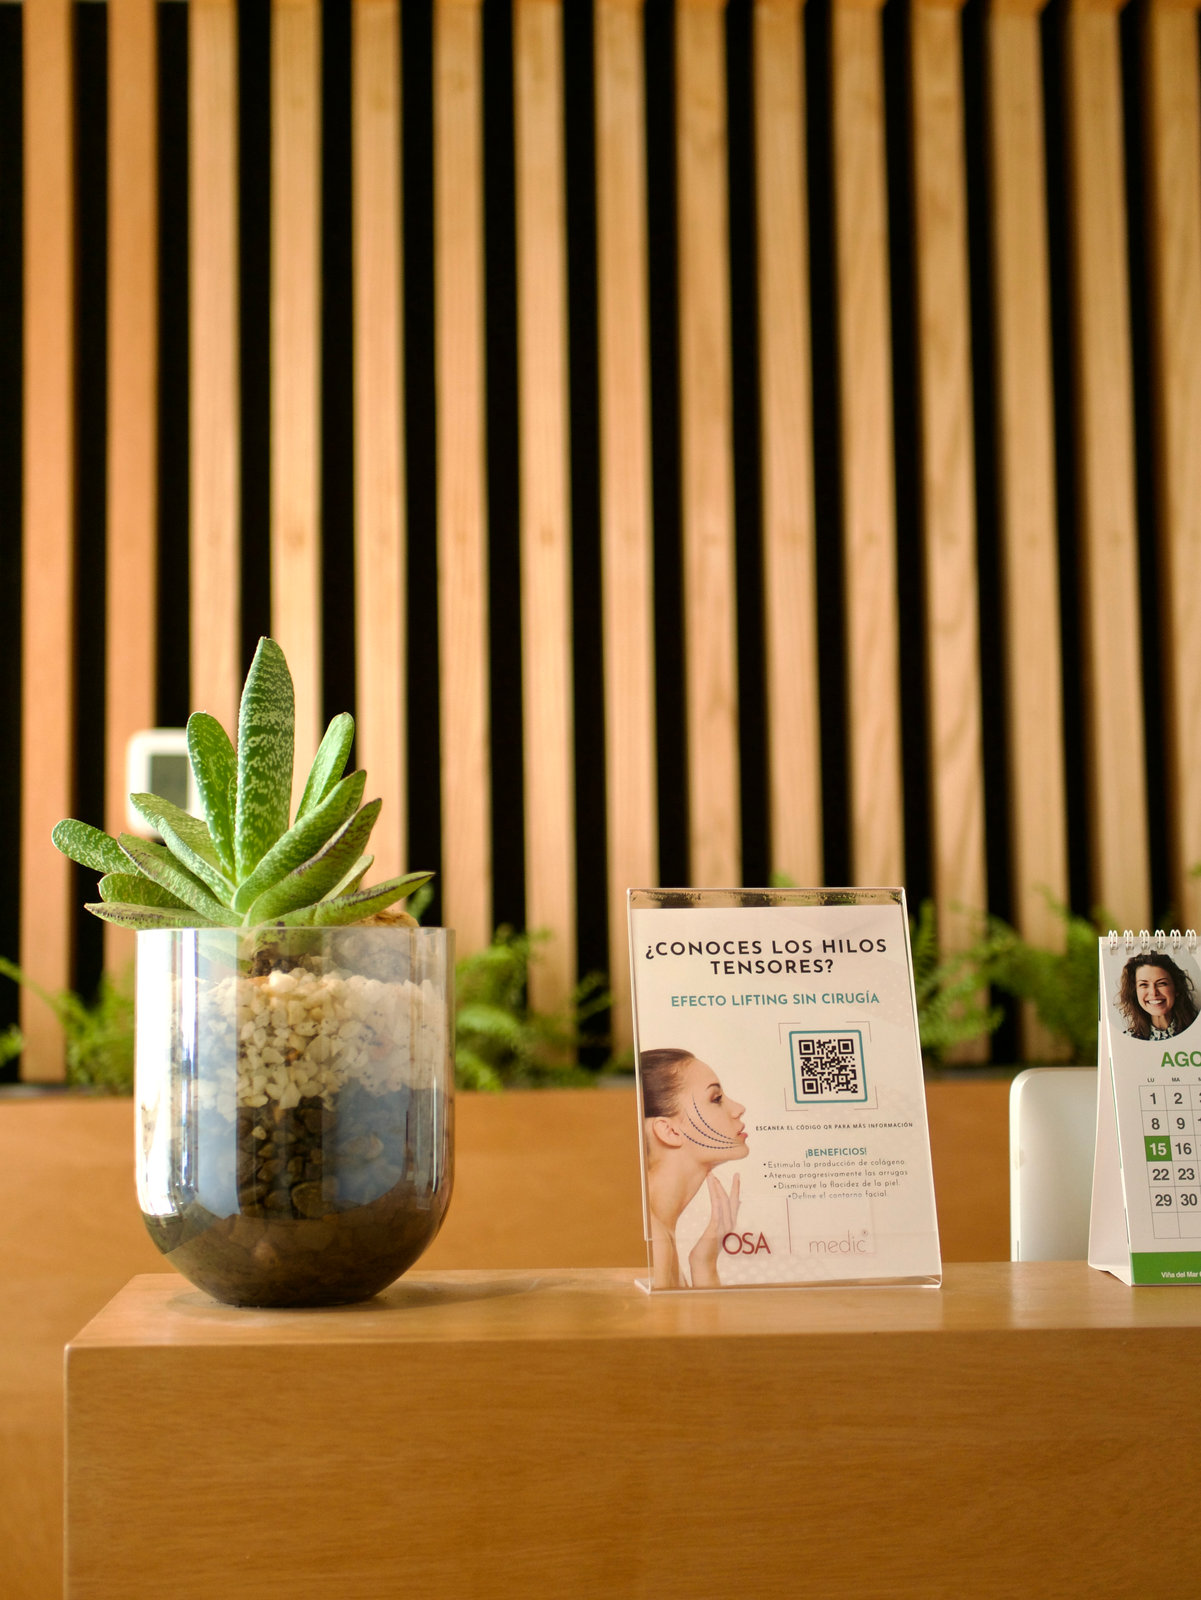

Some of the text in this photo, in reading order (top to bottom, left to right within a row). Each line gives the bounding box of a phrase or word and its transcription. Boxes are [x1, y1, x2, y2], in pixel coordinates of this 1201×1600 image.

[645, 939, 887, 959] ¿CONOCES LOS HILOS
[711, 959, 833, 975] TENSORES?
[671, 990, 879, 1007] EFECTO LIFTING SIN CIRUGÍA
[1150, 1093, 1182, 1104] 1 2
[1152, 1118, 1160, 1130] 8
[1177, 1118, 1185, 1129] 9
[805, 1147, 867, 1158] ¡BENEFICIOS!
[1150, 1143, 1192, 1155] 15 16
[800, 1171, 862, 1181] progresivamente
[879, 1170, 908, 1178] arrugas
[1152, 1168, 1195, 1180] 22 23
[778, 1182, 816, 1190] Disminuye
[1155, 1194, 1197, 1206] 29 30
[722, 1232, 771, 1255] OSA
